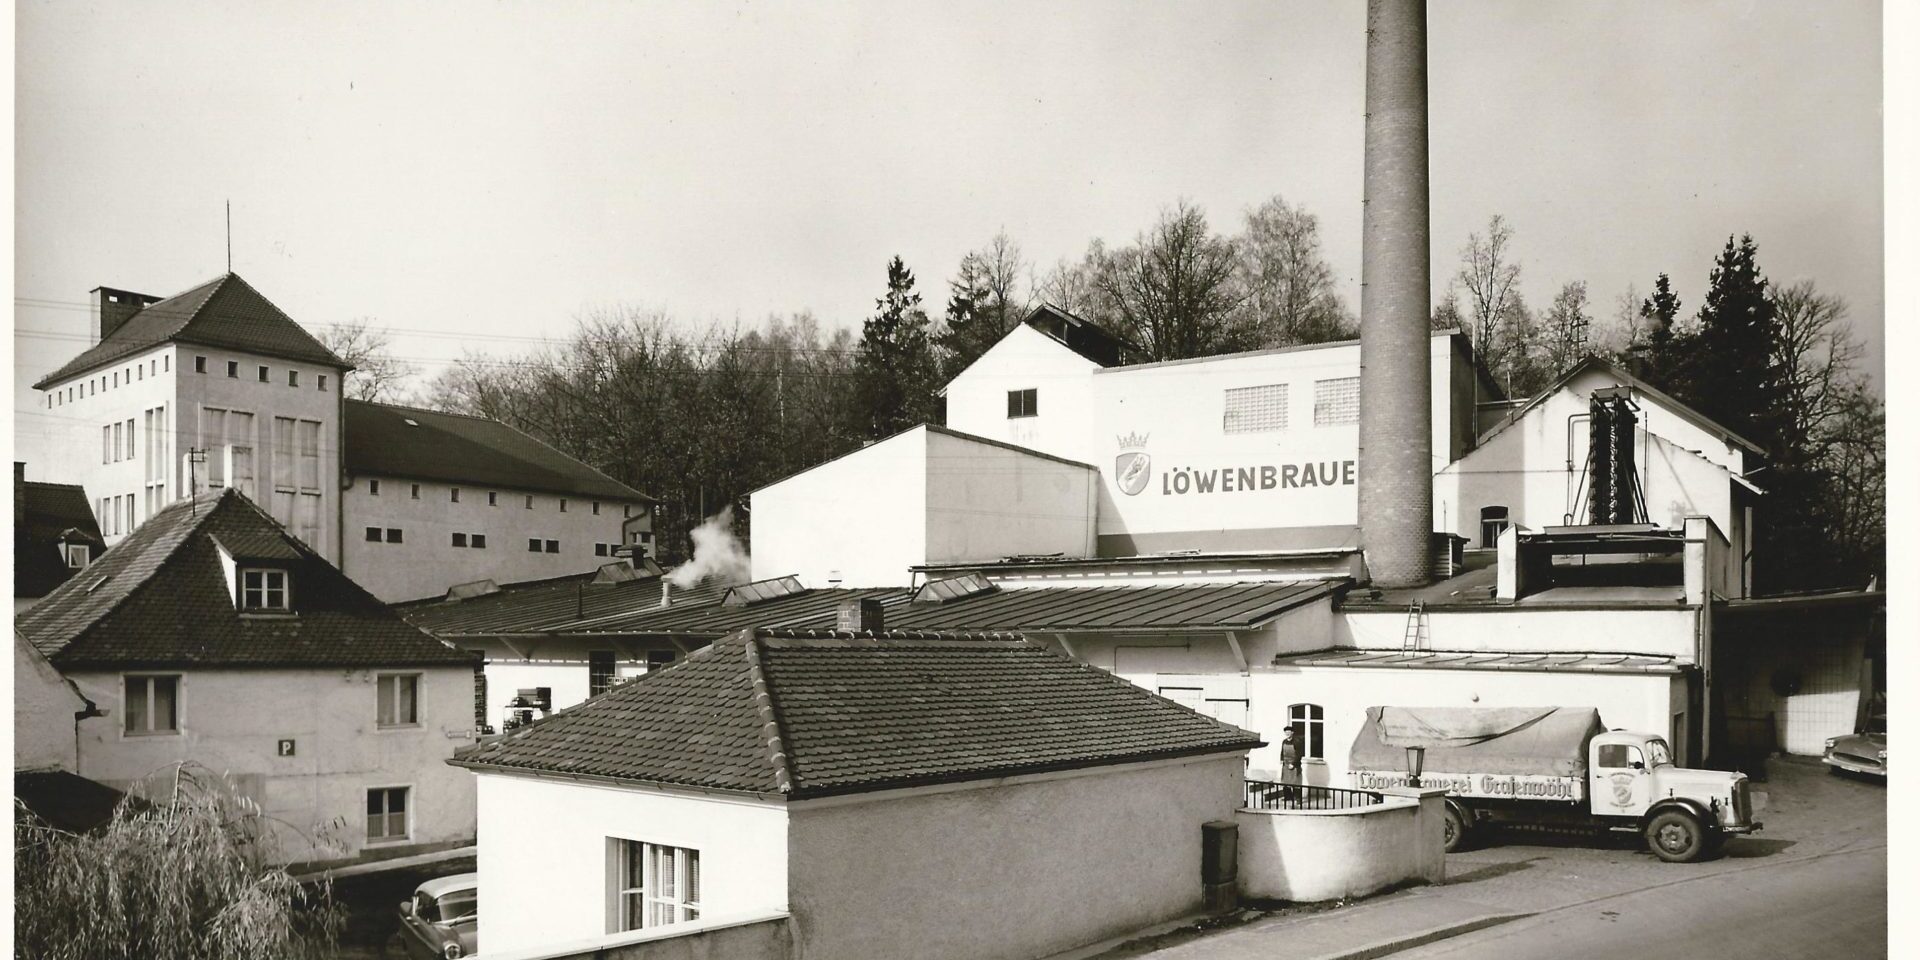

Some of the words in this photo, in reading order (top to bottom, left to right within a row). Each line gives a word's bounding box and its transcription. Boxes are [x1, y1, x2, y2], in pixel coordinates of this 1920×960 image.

[1163, 460, 1355, 495] LÖWENBRAUE
[282, 741, 292, 755] P
[1360, 772, 1473, 793] Löwenauerei
